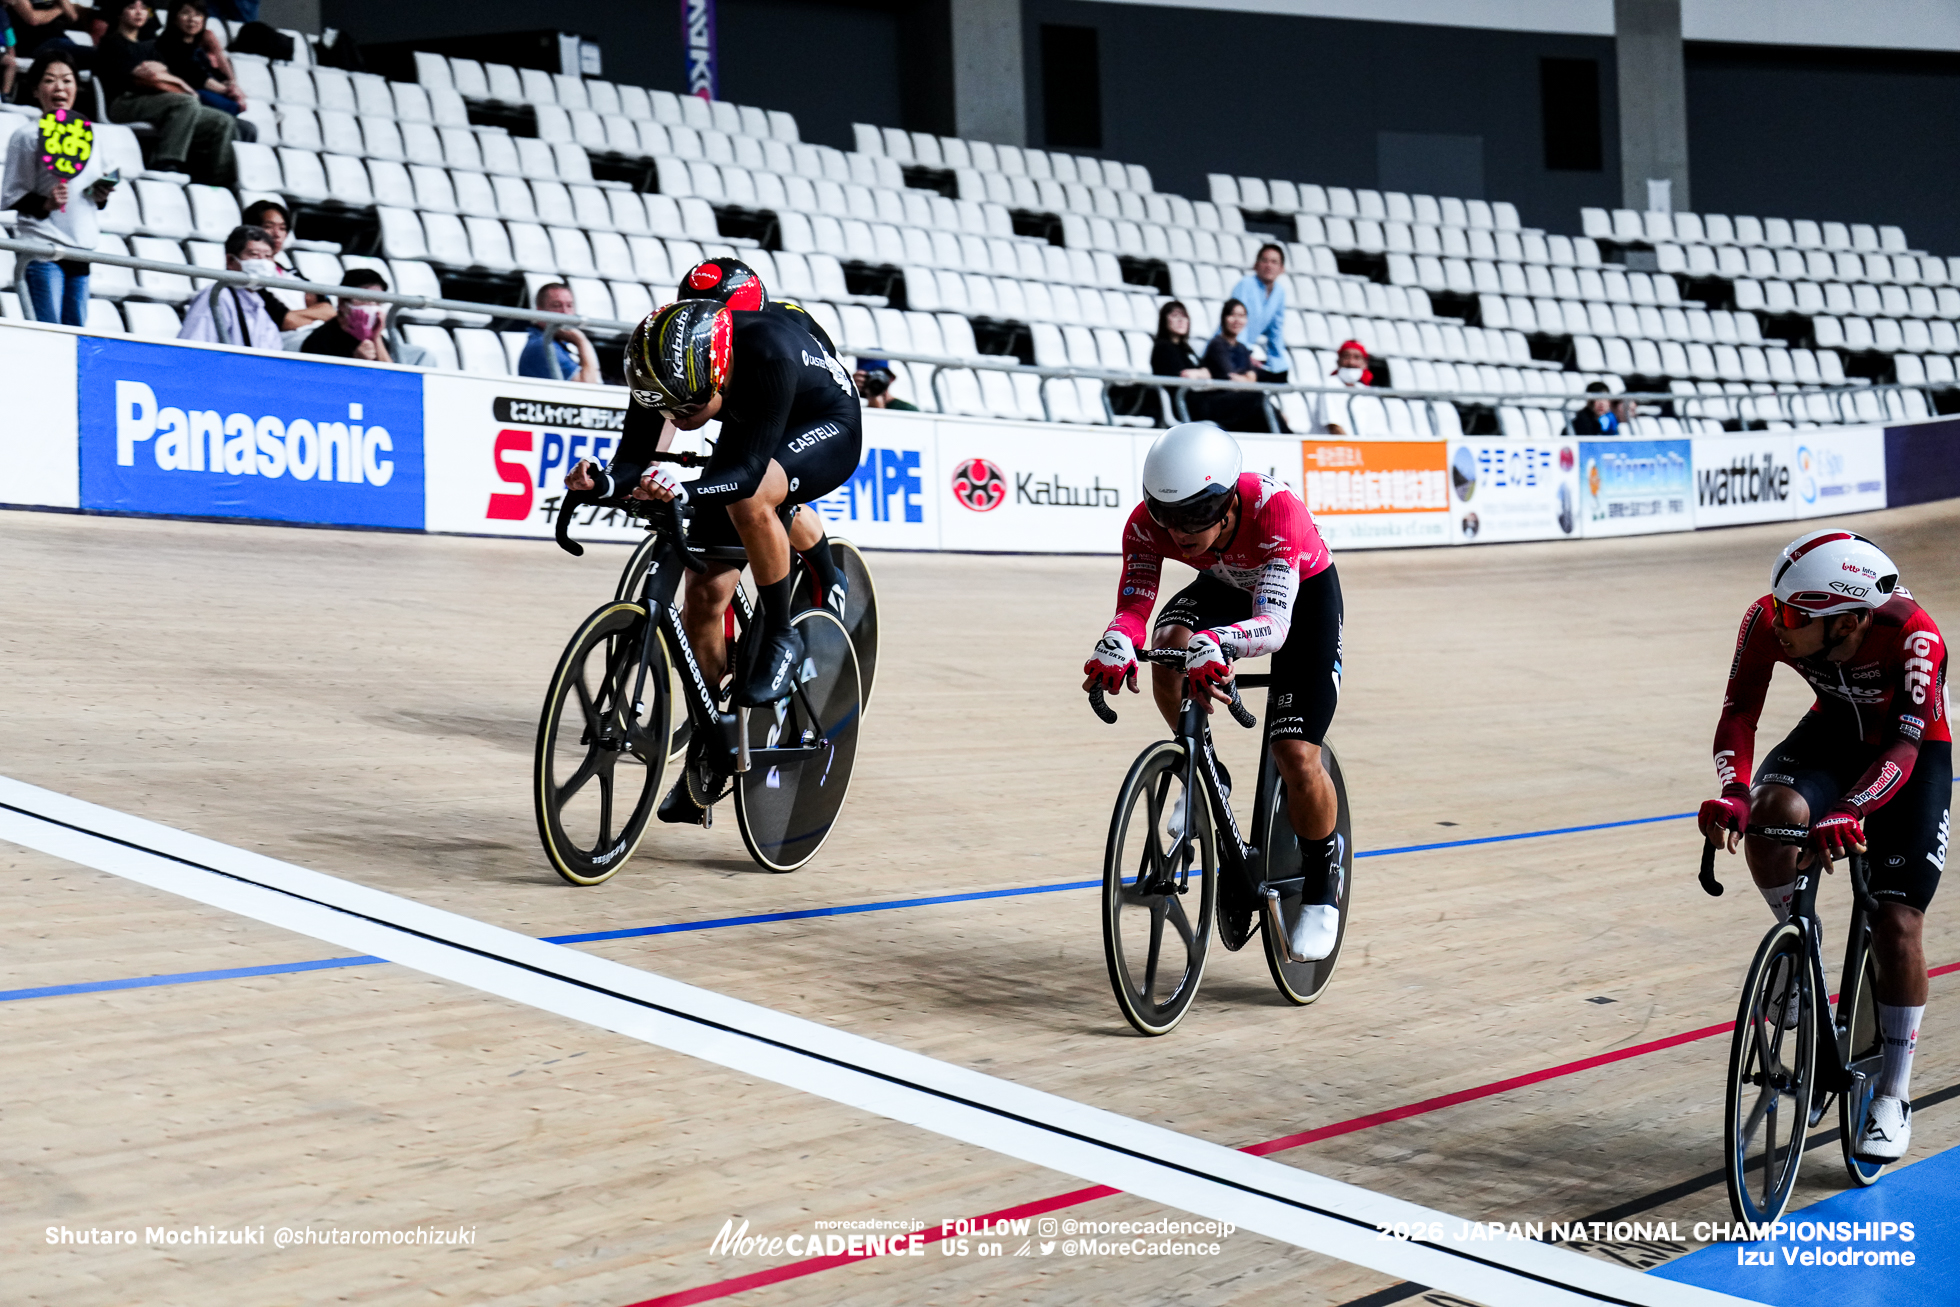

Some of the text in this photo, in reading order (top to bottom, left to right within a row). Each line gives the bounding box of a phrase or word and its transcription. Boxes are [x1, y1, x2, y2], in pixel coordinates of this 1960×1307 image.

[672, 310, 690, 380] Kabuto
[115, 380, 394, 487] Panasonic
[788, 423, 840, 453] CASTELLI
[697, 482, 738, 494] CASTELLI
[1016, 472, 1119, 507] Kabuto
[1698, 453, 1789, 506] wattbike
[1132, 579, 1156, 588] COSMO
[1135, 587, 1155, 600] MJS
[1262, 588, 1287, 598] COSMO
[1267, 597, 1287, 609] MJS
[1231, 625, 1272, 640] TEAM UKYO
[670, 608, 720, 725] BRIDGESTONE
[1852, 669, 1882, 680] caps
[1903, 630, 1940, 705] lotto
